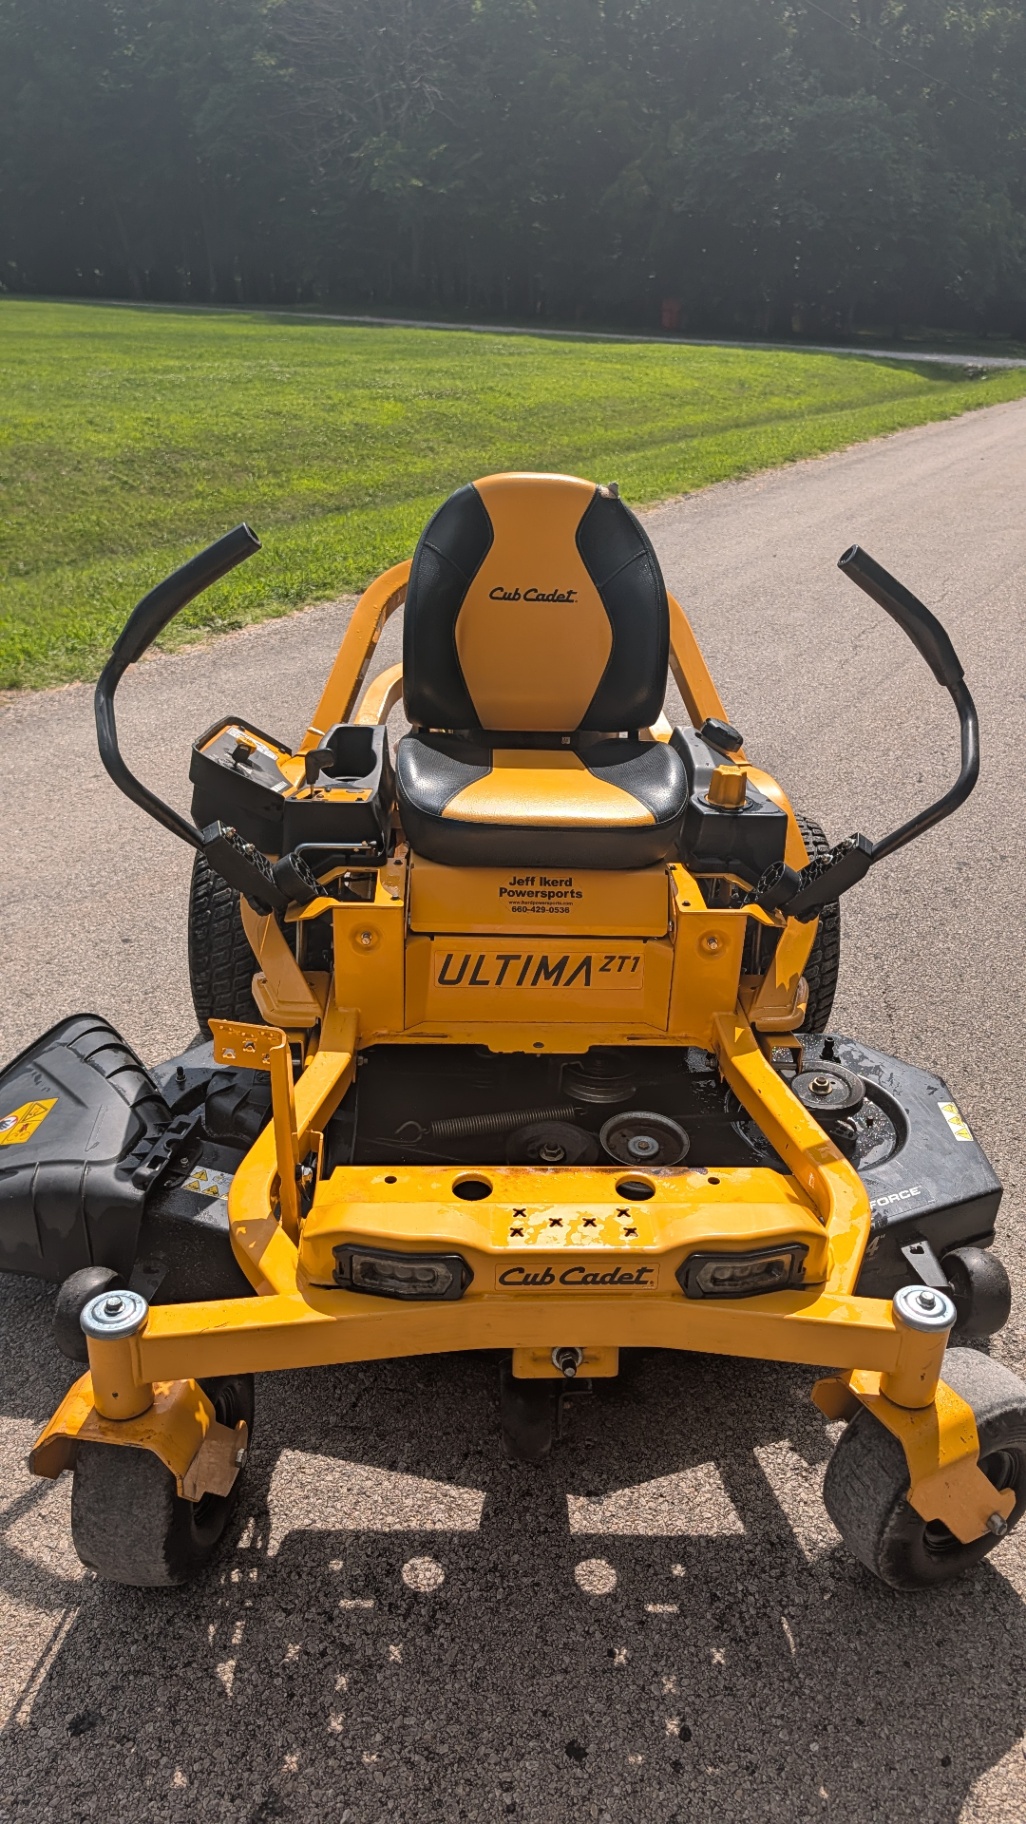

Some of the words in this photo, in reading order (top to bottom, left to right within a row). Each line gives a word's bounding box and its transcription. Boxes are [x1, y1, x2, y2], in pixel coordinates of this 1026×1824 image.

[489, 587, 521, 601] Cub
[523, 588, 577, 602] Cadet
[509, 876, 536, 886] Jeff
[539, 877, 573, 887] Ikerd
[499, 887, 583, 900] Powersports
[437, 953, 592, 987] ULTIMA
[598, 955, 640, 972] ZT1
[498, 1266, 555, 1285] Cub
[559, 1266, 654, 1286] Cadet
